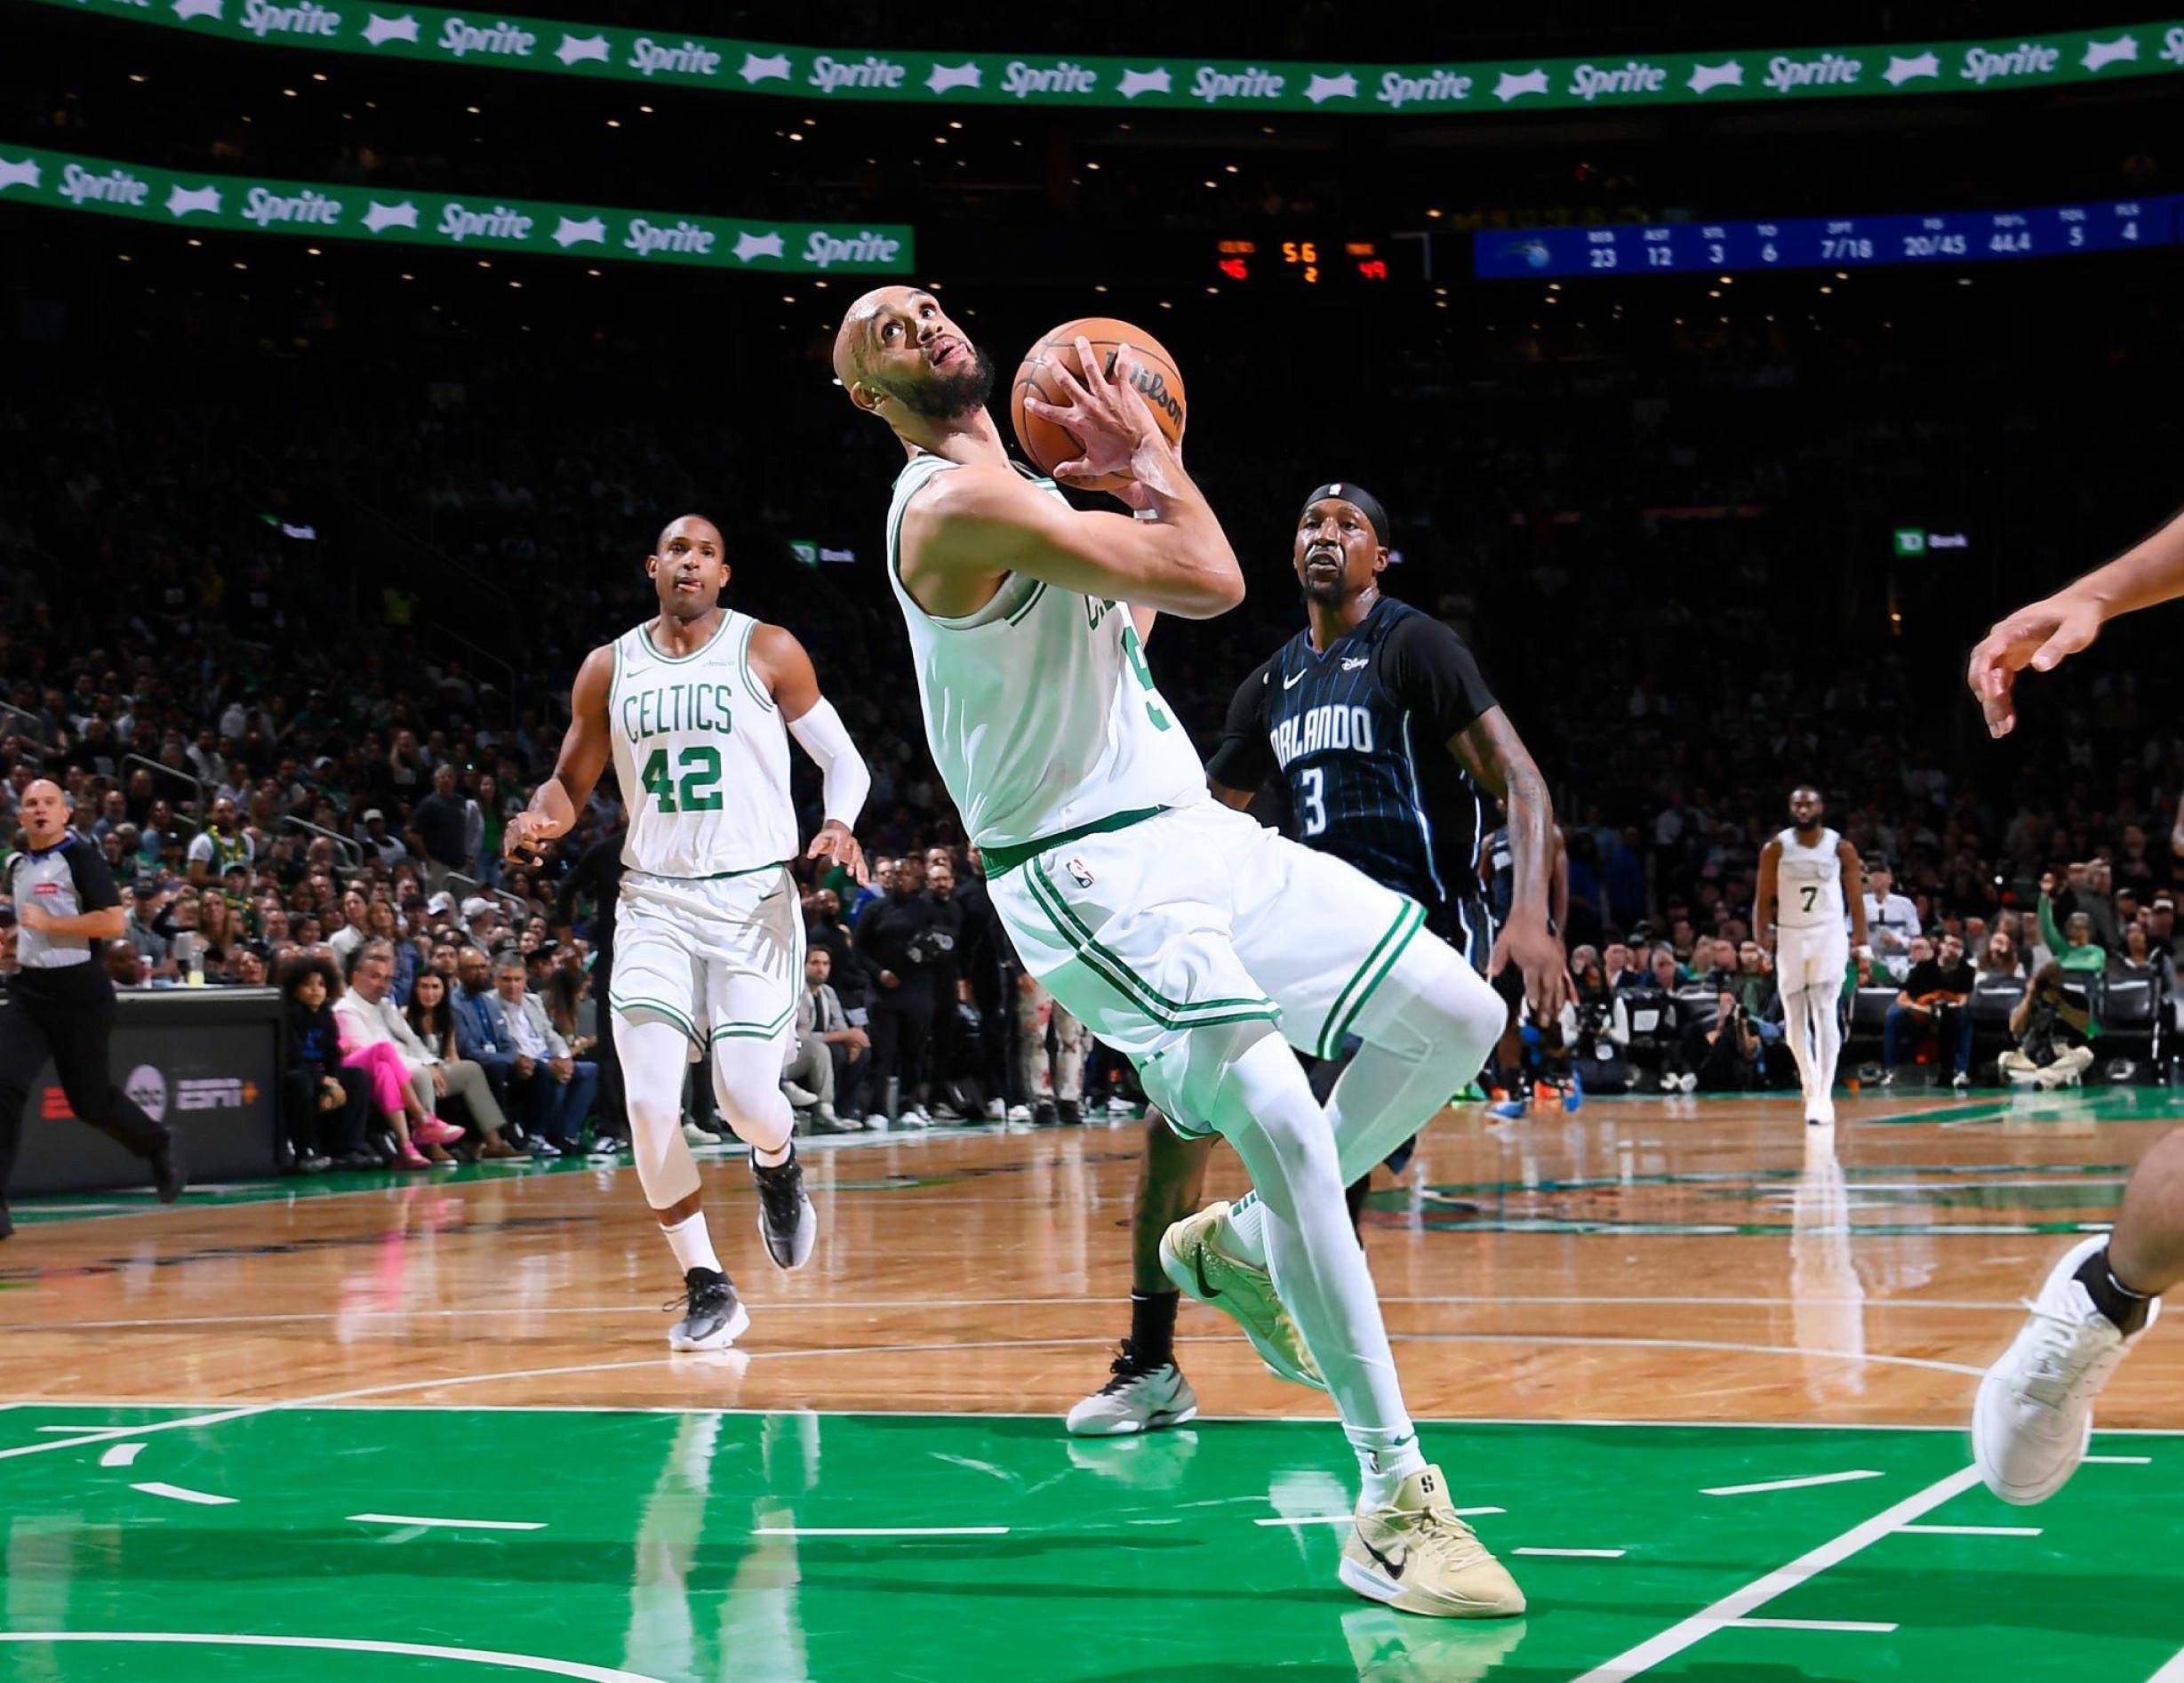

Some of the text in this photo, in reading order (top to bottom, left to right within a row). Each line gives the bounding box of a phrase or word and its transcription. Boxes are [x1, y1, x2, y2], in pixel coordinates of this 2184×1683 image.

[241, 0, 2060, 108] Sprite Sprite Sprite Sprite Sprite Sprite Sprite Sprite Sprite Sprite
[59, 164, 899, 268] Sprite Sprite Sprite Sprite Sprite
[1589, 248, 1617, 268] 23
[1647, 246, 1673, 267] 12
[1708, 244, 1725, 264] 3
[1761, 242, 1779, 263] 6
[1820, 238, 1874, 259] 7/18
[1902, 234, 1967, 257] 20/45
[2121, 221, 2138, 241] 4
[623, 683, 732, 744] CELTICS
[1270, 703, 1373, 773] ORLANDO
[641, 745, 724, 813] 42
[1301, 766, 1327, 836] 3
[1799, 886, 1819, 913] 7
